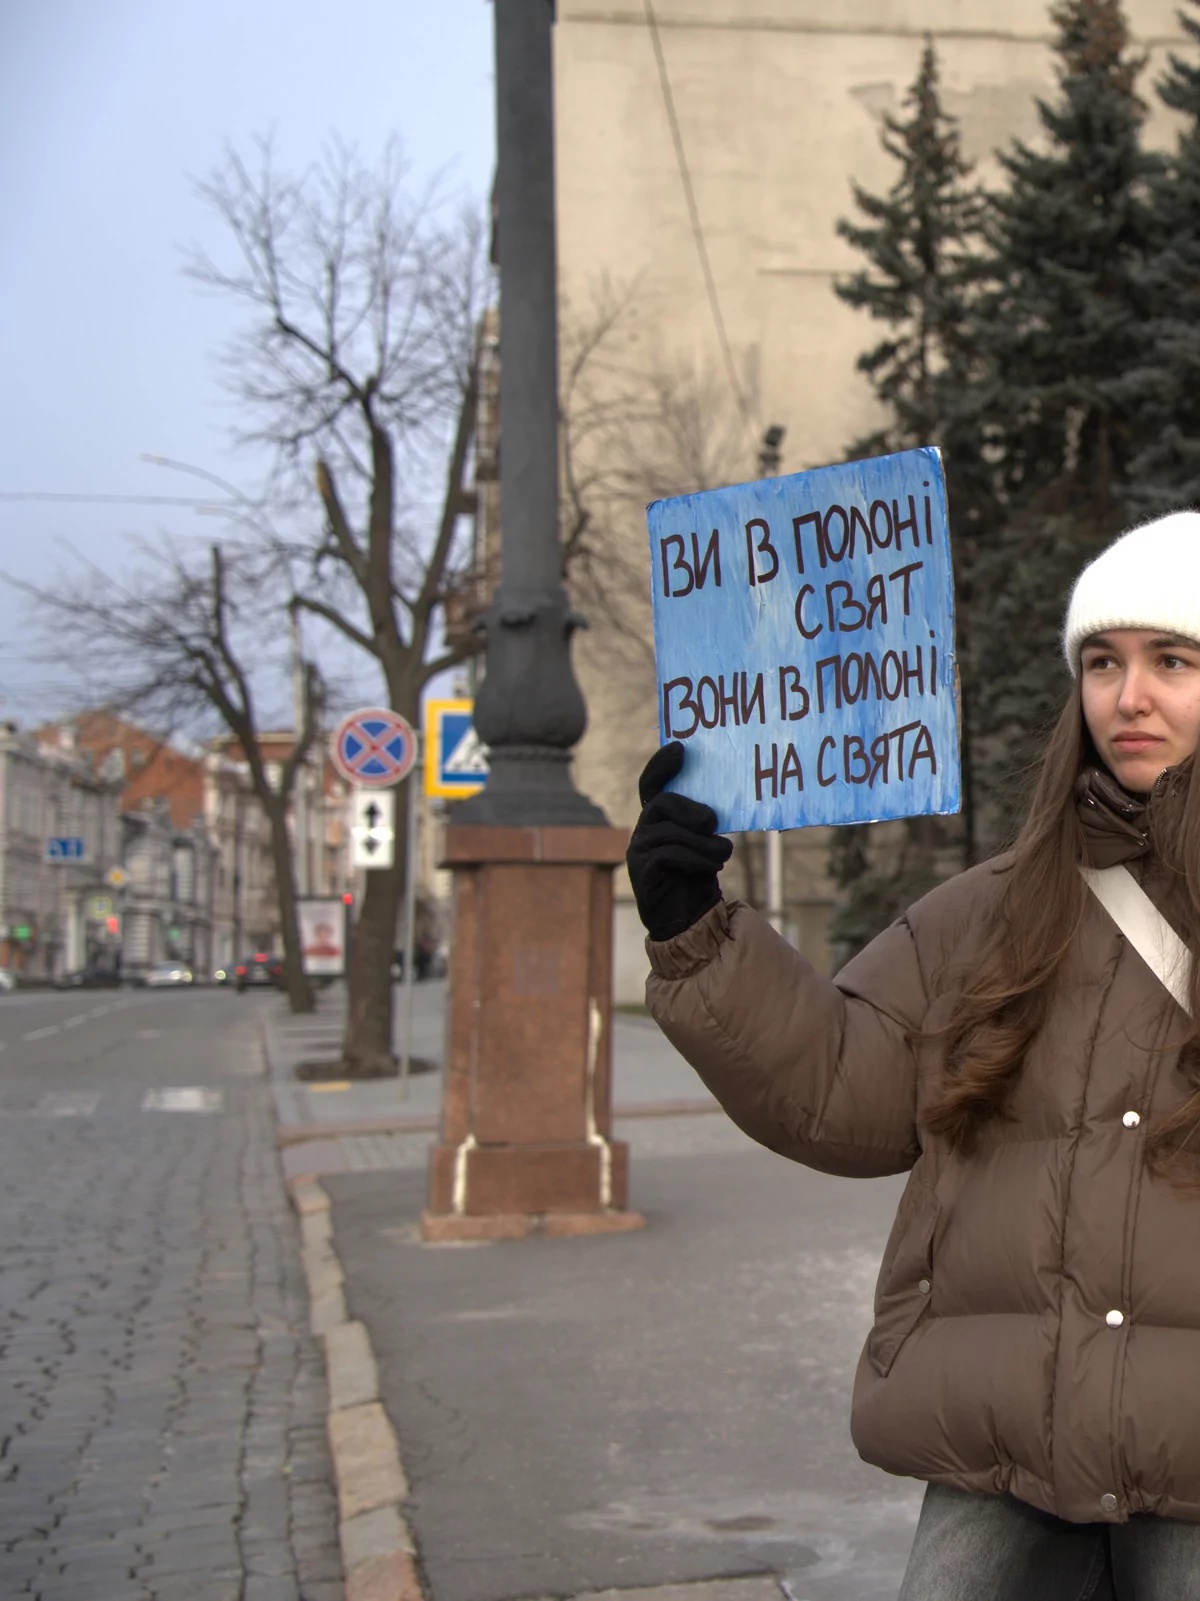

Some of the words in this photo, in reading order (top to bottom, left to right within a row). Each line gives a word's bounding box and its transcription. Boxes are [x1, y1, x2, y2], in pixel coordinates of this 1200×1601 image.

[659, 528, 722, 598] ВИ
[744, 517, 780, 587] В
[795, 561, 924, 640] СВЯТ
[663, 672, 766, 739] ВОНИ
[778, 666, 810, 722] В
[754, 742, 804, 801] НА
[816, 719, 938, 790] СВЯТА
